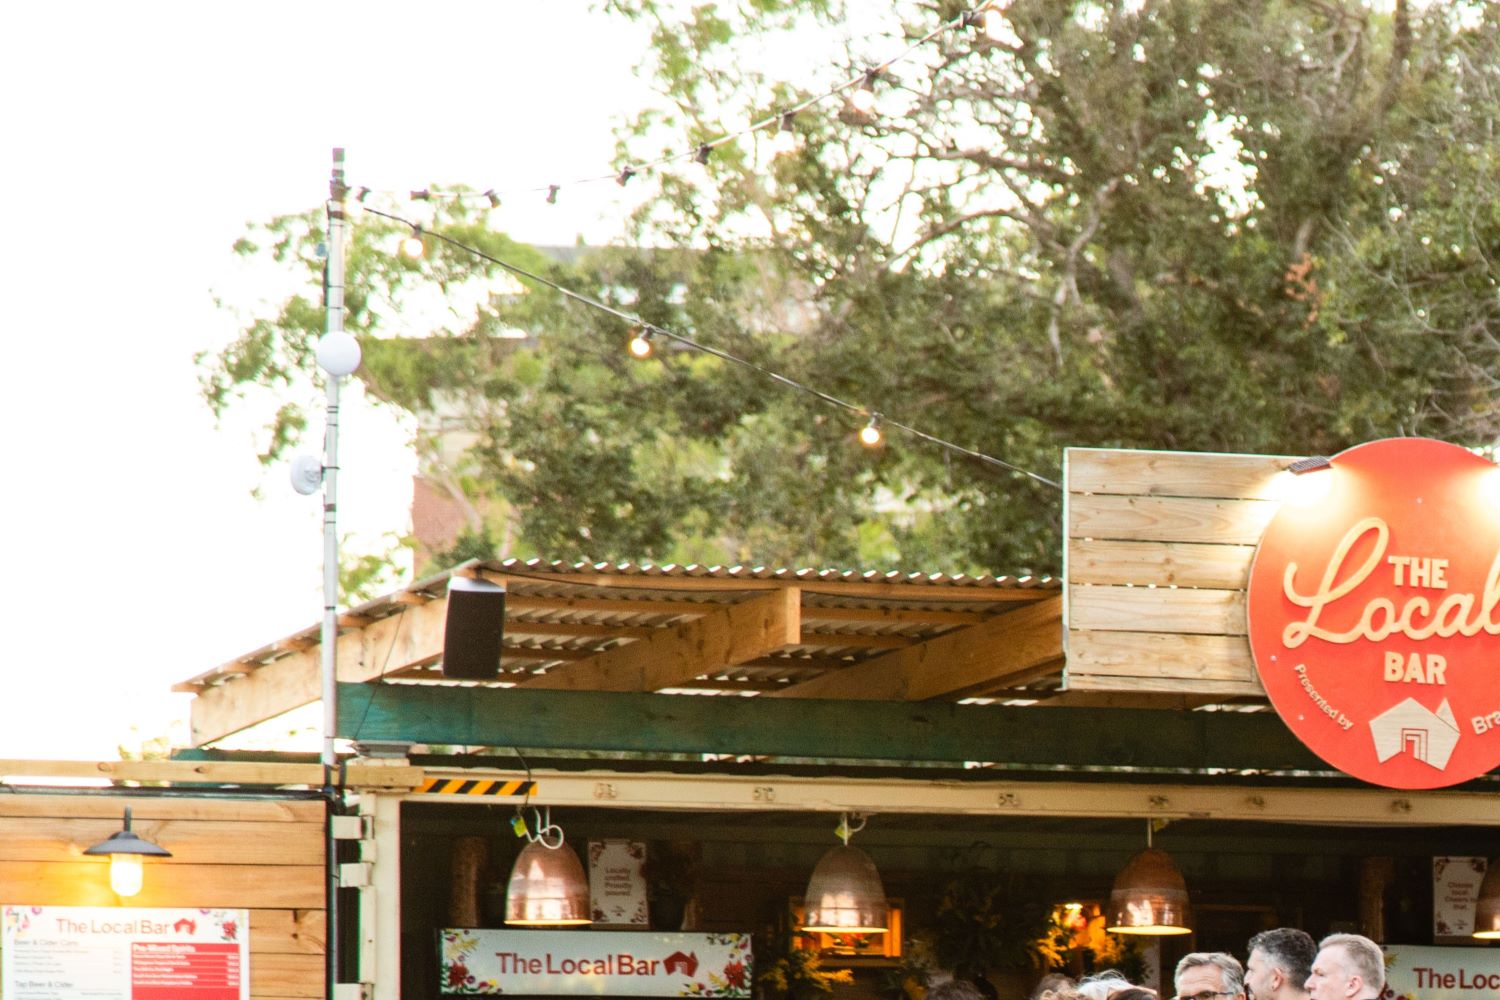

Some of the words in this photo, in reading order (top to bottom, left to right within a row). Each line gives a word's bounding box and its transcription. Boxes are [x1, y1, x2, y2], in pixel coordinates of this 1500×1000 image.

[1388, 555, 1449, 589] THE
[1384, 651, 1447, 685] BAR
[1294, 663, 1339, 719] Presented
[1337, 713, 1354, 730] by
[56, 918, 88, 934] The
[91, 919, 137, 935] Local
[141, 920, 170, 935] Bar
[495, 952, 542, 974] The
[546, 953, 613, 975] Local
[617, 954, 660, 976] Bar
[1412, 967, 1456, 989] The
